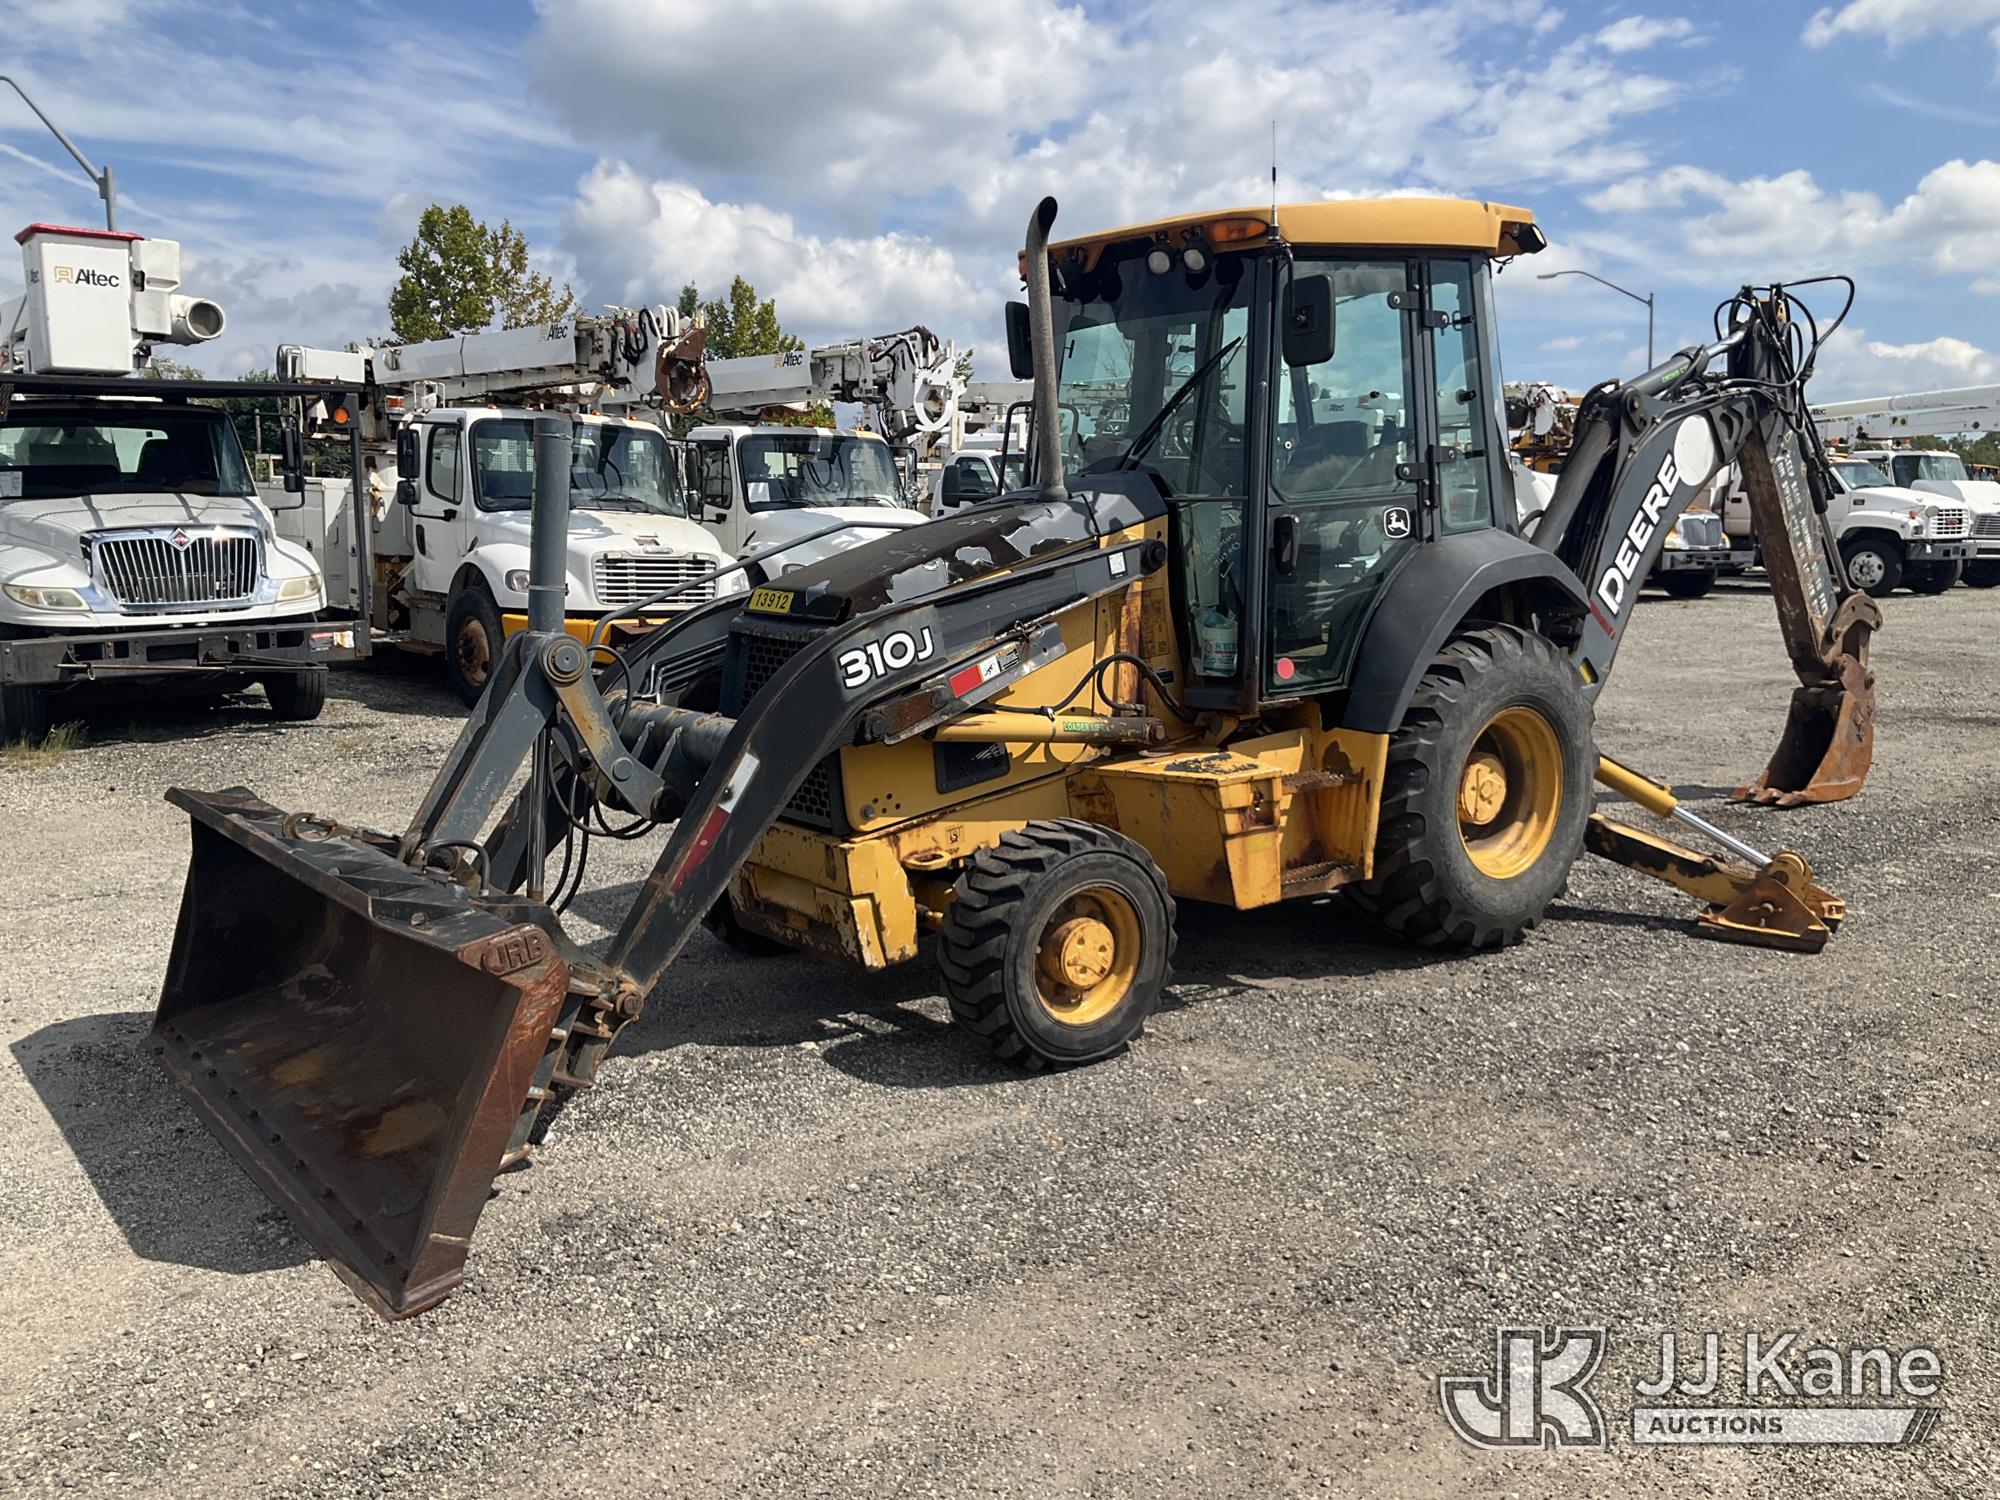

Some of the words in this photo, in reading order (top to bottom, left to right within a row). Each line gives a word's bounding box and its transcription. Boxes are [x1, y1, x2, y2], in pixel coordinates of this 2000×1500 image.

[75, 268, 119, 288] Altec
[547, 323, 568, 341] Altec
[782, 351, 802, 367] Altec
[1597, 451, 1680, 616] DEERE
[756, 591, 789, 609] 13912
[837, 625, 934, 690] 310J
[1064, 721, 1089, 732] LOADER
